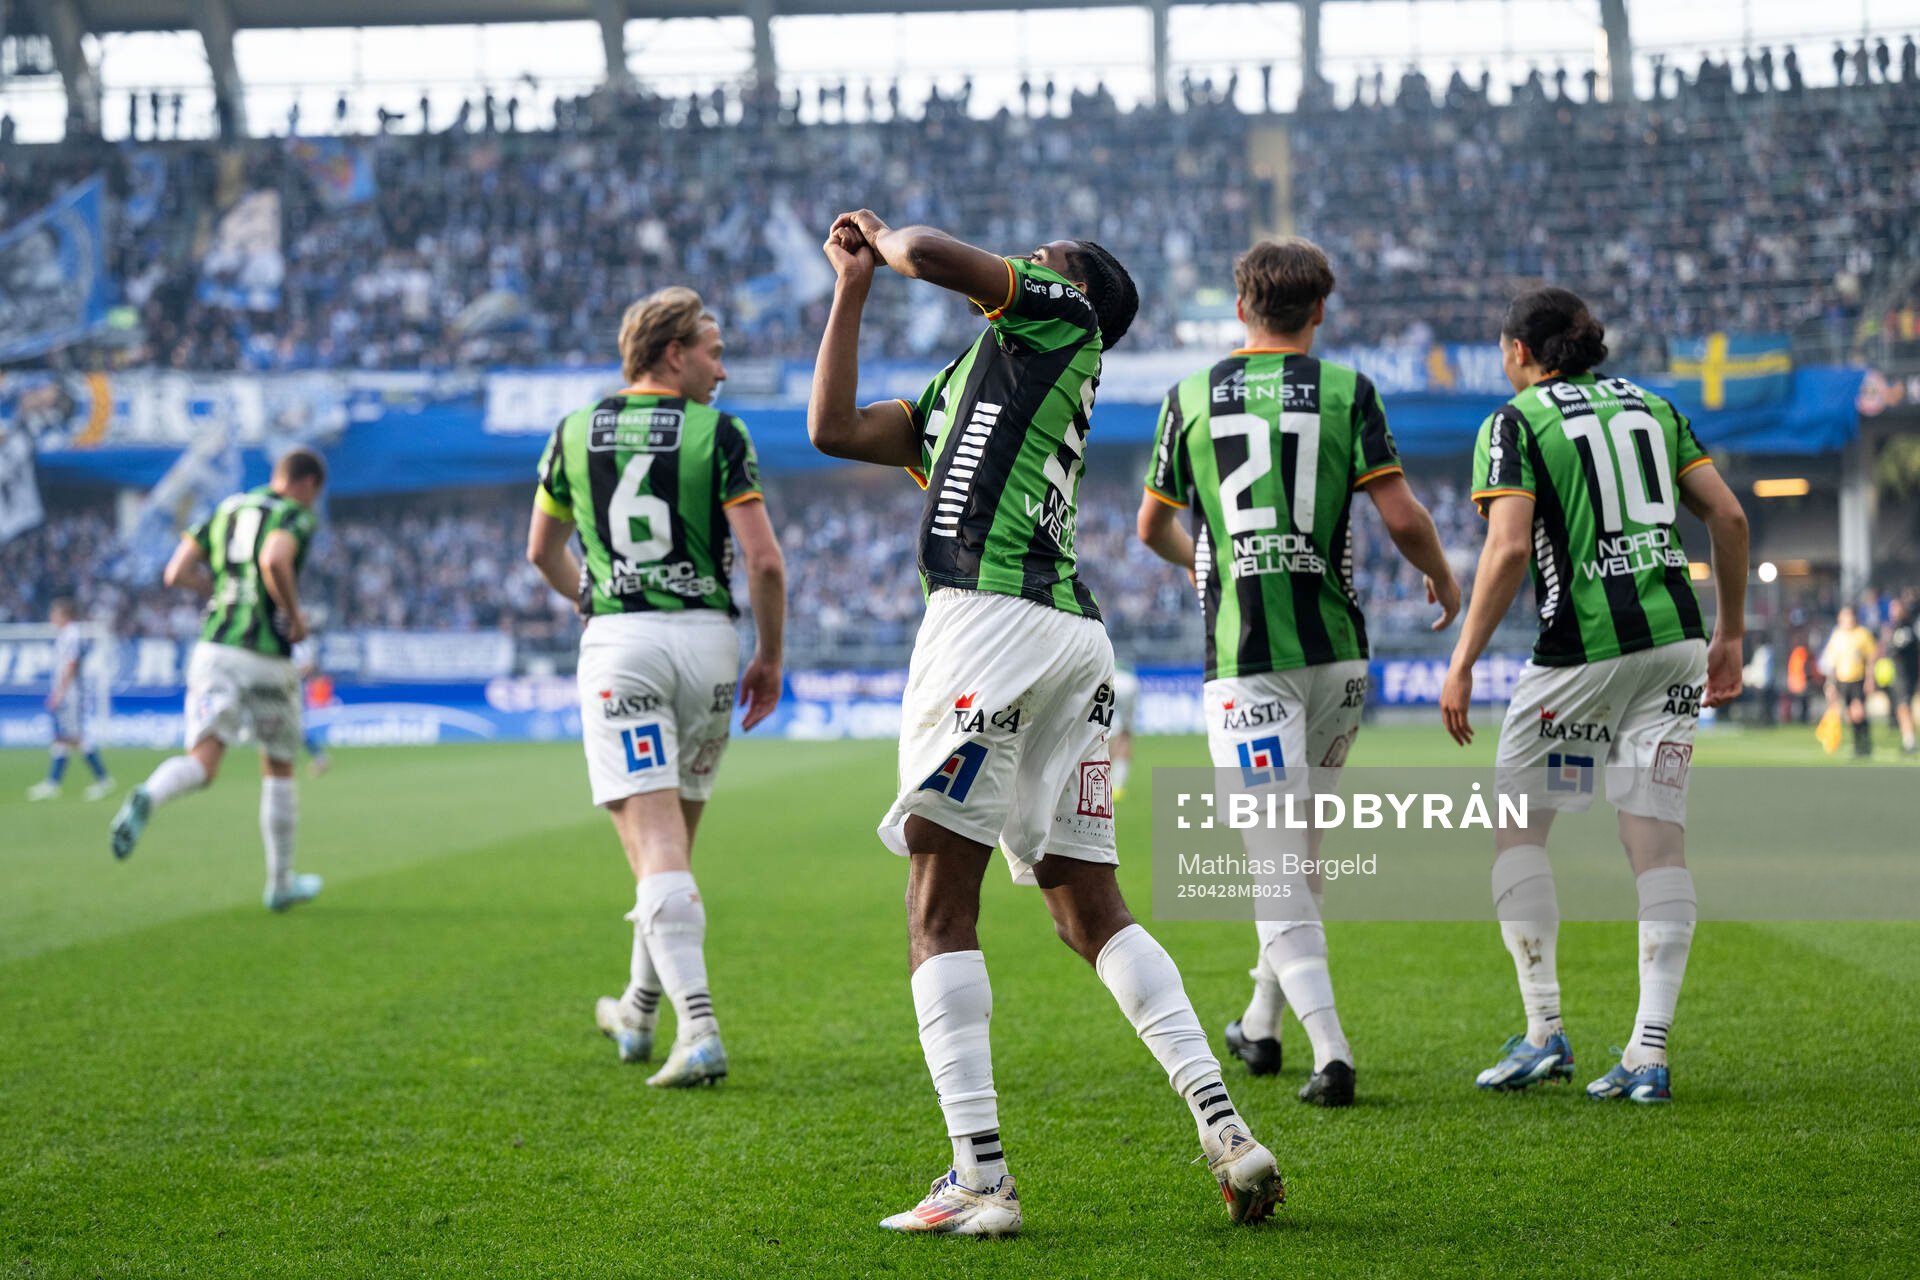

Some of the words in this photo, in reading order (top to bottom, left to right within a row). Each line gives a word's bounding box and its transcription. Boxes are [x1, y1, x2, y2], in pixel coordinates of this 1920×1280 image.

[1024, 279, 1047, 295] Care
[1212, 384, 1316, 403] ERNST
[1561, 410, 1677, 533] 10
[608, 454, 674, 563] 6
[1224, 701, 1288, 730] RASTA
[1539, 720, 1612, 743] RASTA
